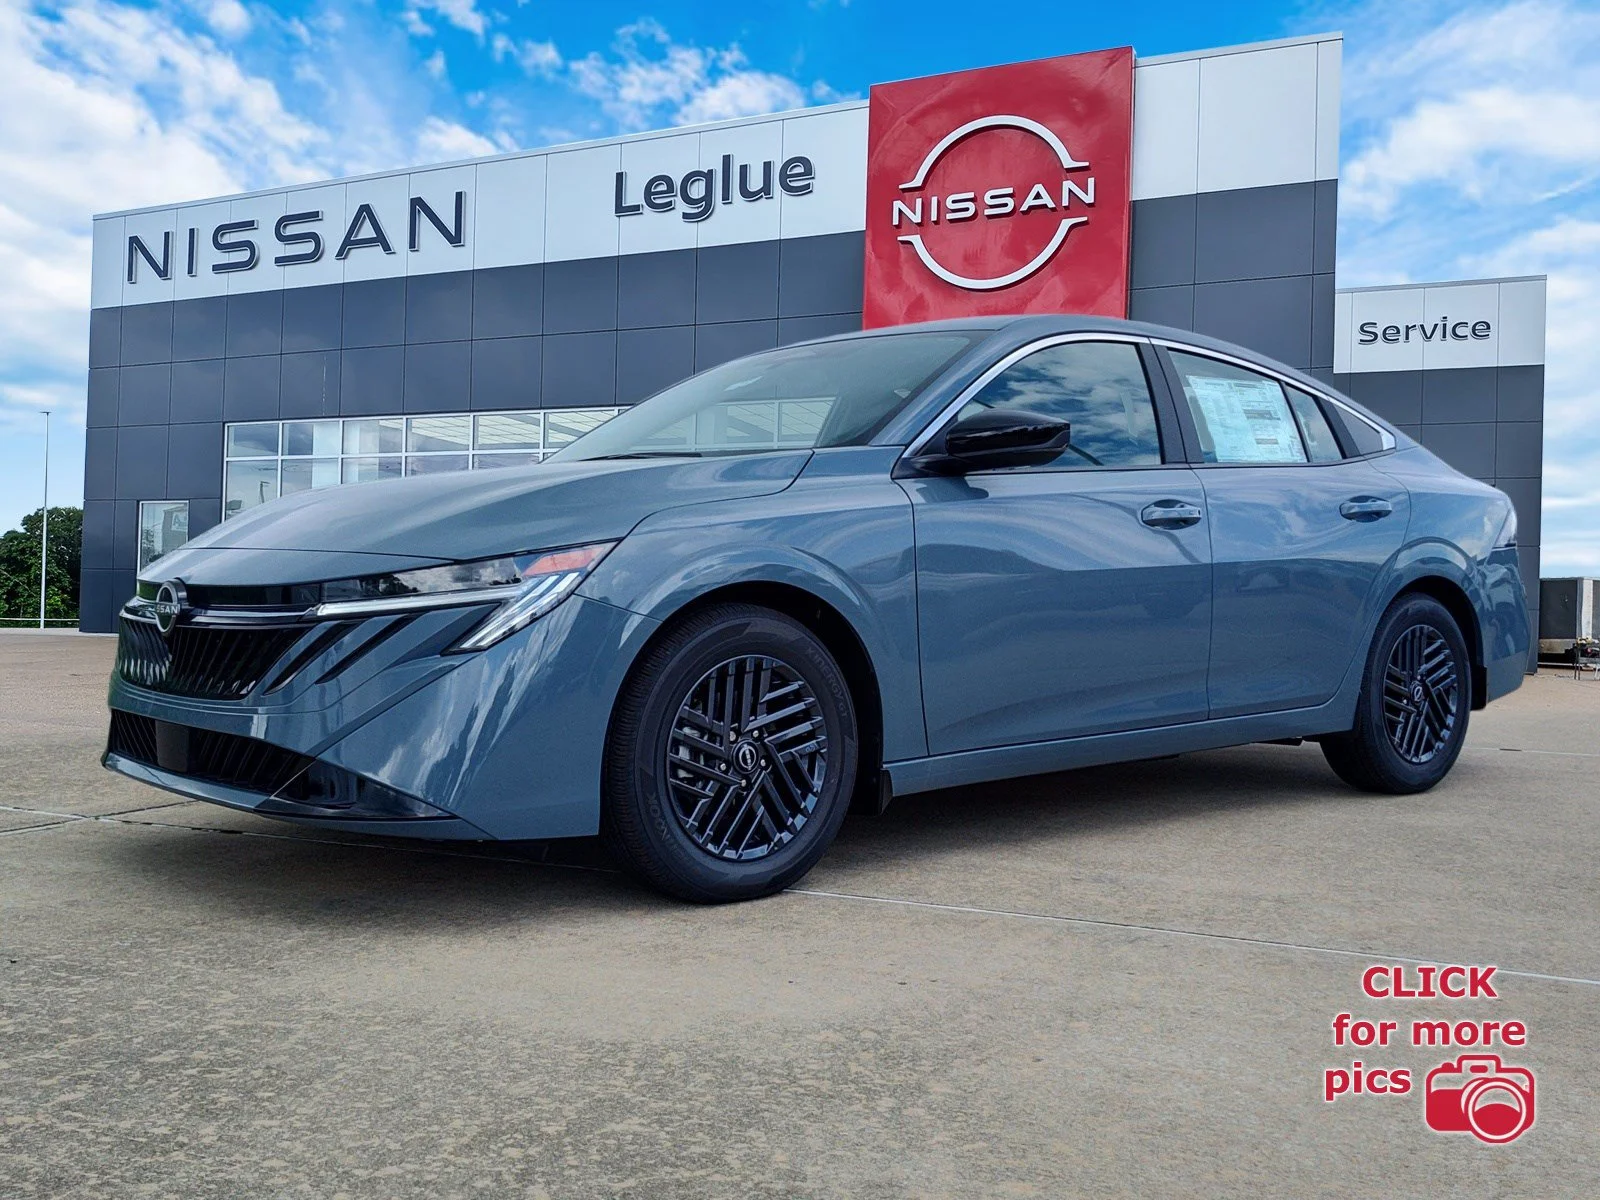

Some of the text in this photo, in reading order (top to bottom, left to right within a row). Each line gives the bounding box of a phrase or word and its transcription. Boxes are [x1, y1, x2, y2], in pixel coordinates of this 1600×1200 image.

[614, 154, 816, 222] Leglue
[892, 177, 1095, 227] NISSAN
[127, 190, 467, 284] NISSAN
[1358, 316, 1492, 345] Service
